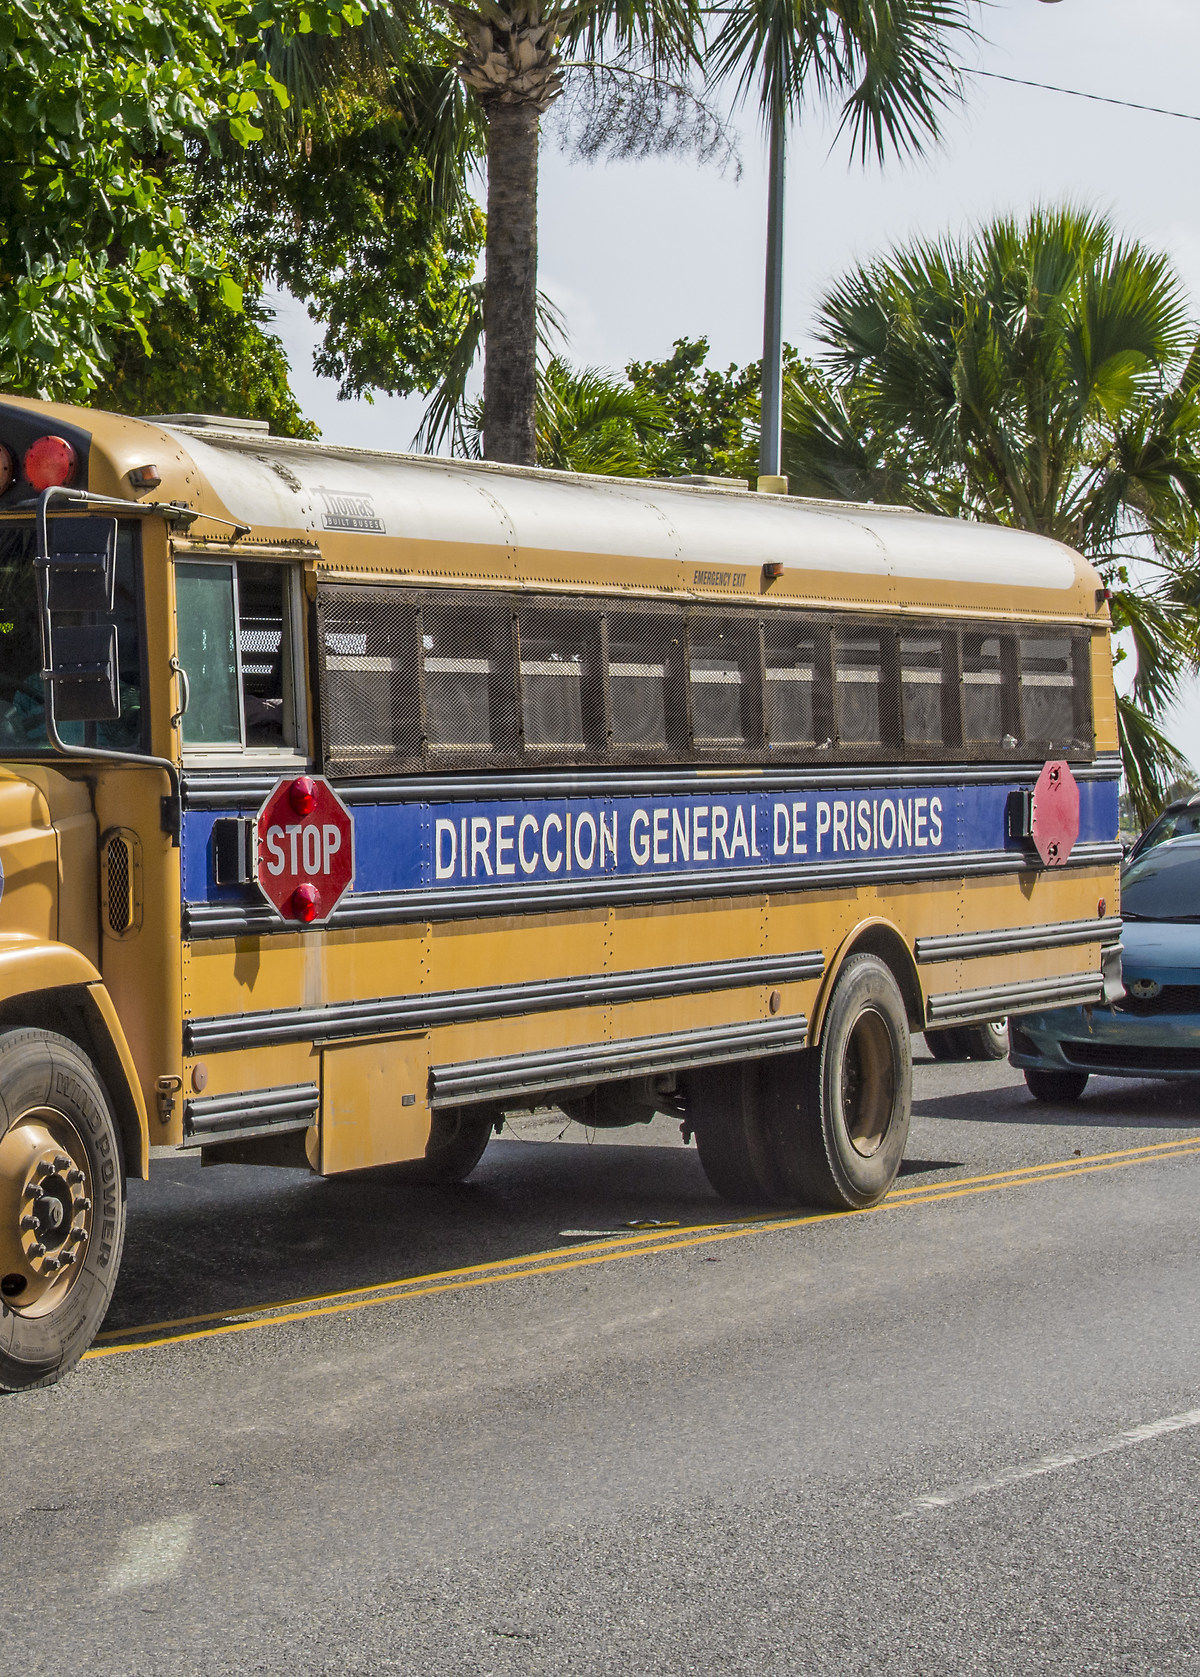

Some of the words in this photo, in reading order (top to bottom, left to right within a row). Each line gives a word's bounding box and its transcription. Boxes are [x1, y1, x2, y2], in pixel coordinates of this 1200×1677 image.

[309, 485, 375, 518] Thomas
[327, 517, 349, 527] BUILT
[353, 519, 380, 529] BUSES
[693, 570, 731, 587] EMERGENCY
[732, 573, 747, 588] EXIT
[266, 824, 342, 876] STOP
[435, 811, 618, 880] DIRECCION
[629, 804, 761, 866] GENERAL
[773, 802, 808, 855] DE
[816, 796, 944, 852] PRISIONES
